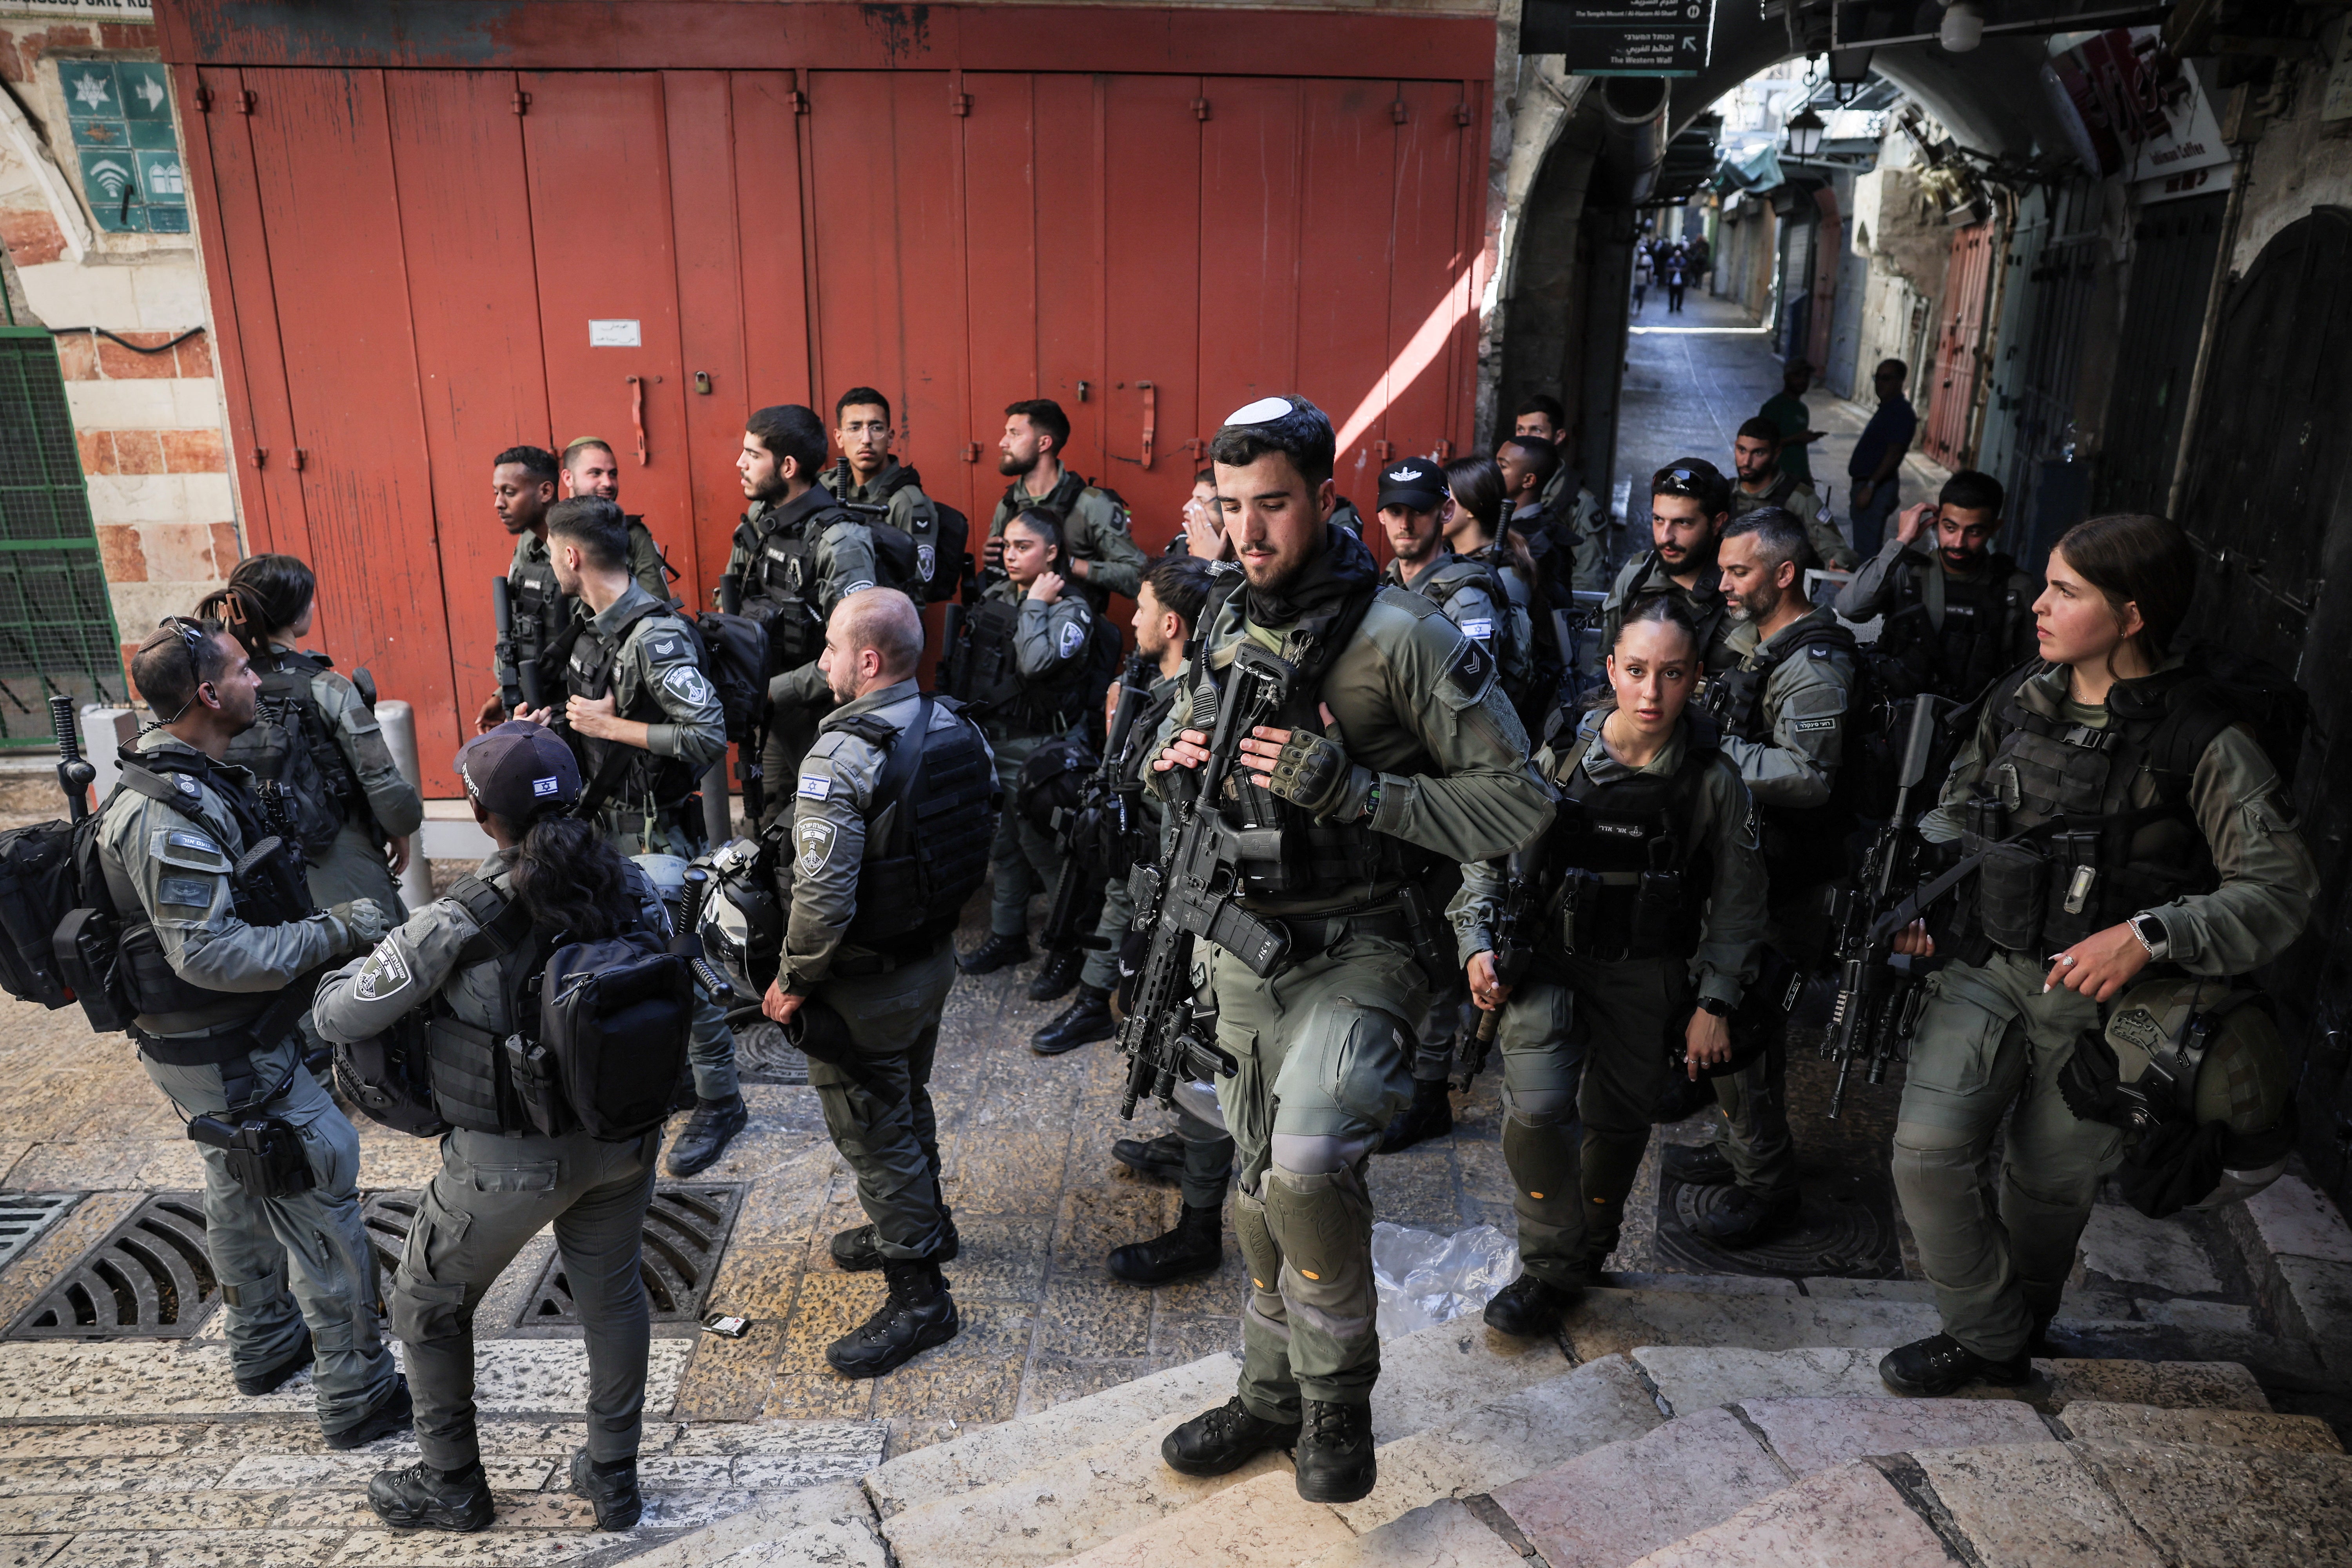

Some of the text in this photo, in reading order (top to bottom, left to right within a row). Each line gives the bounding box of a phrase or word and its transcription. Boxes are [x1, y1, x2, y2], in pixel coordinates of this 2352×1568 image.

[2177, 141, 2205, 159] Coffee
[799, 822, 832, 833] משטרת ישראל
[381, 938, 407, 979] משטרת ישראל
